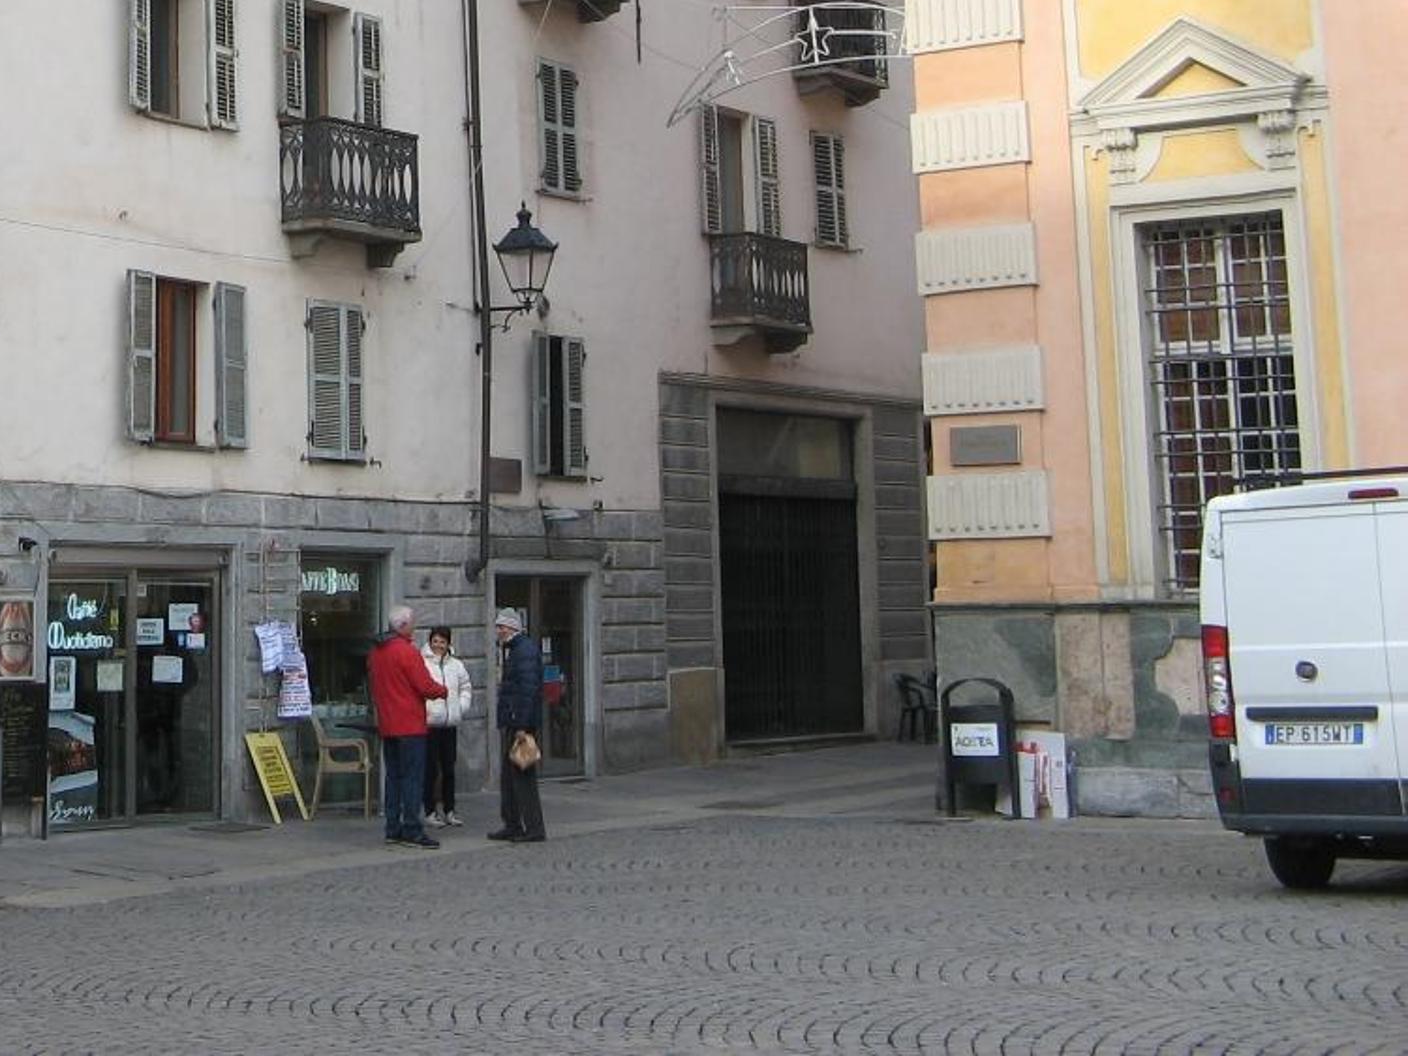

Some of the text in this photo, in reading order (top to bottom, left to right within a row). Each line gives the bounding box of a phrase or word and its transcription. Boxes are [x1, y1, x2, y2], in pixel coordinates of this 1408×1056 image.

[48, 621, 114, 650] Quotidiano
[1276, 725, 1350, 742] EP 615WT
